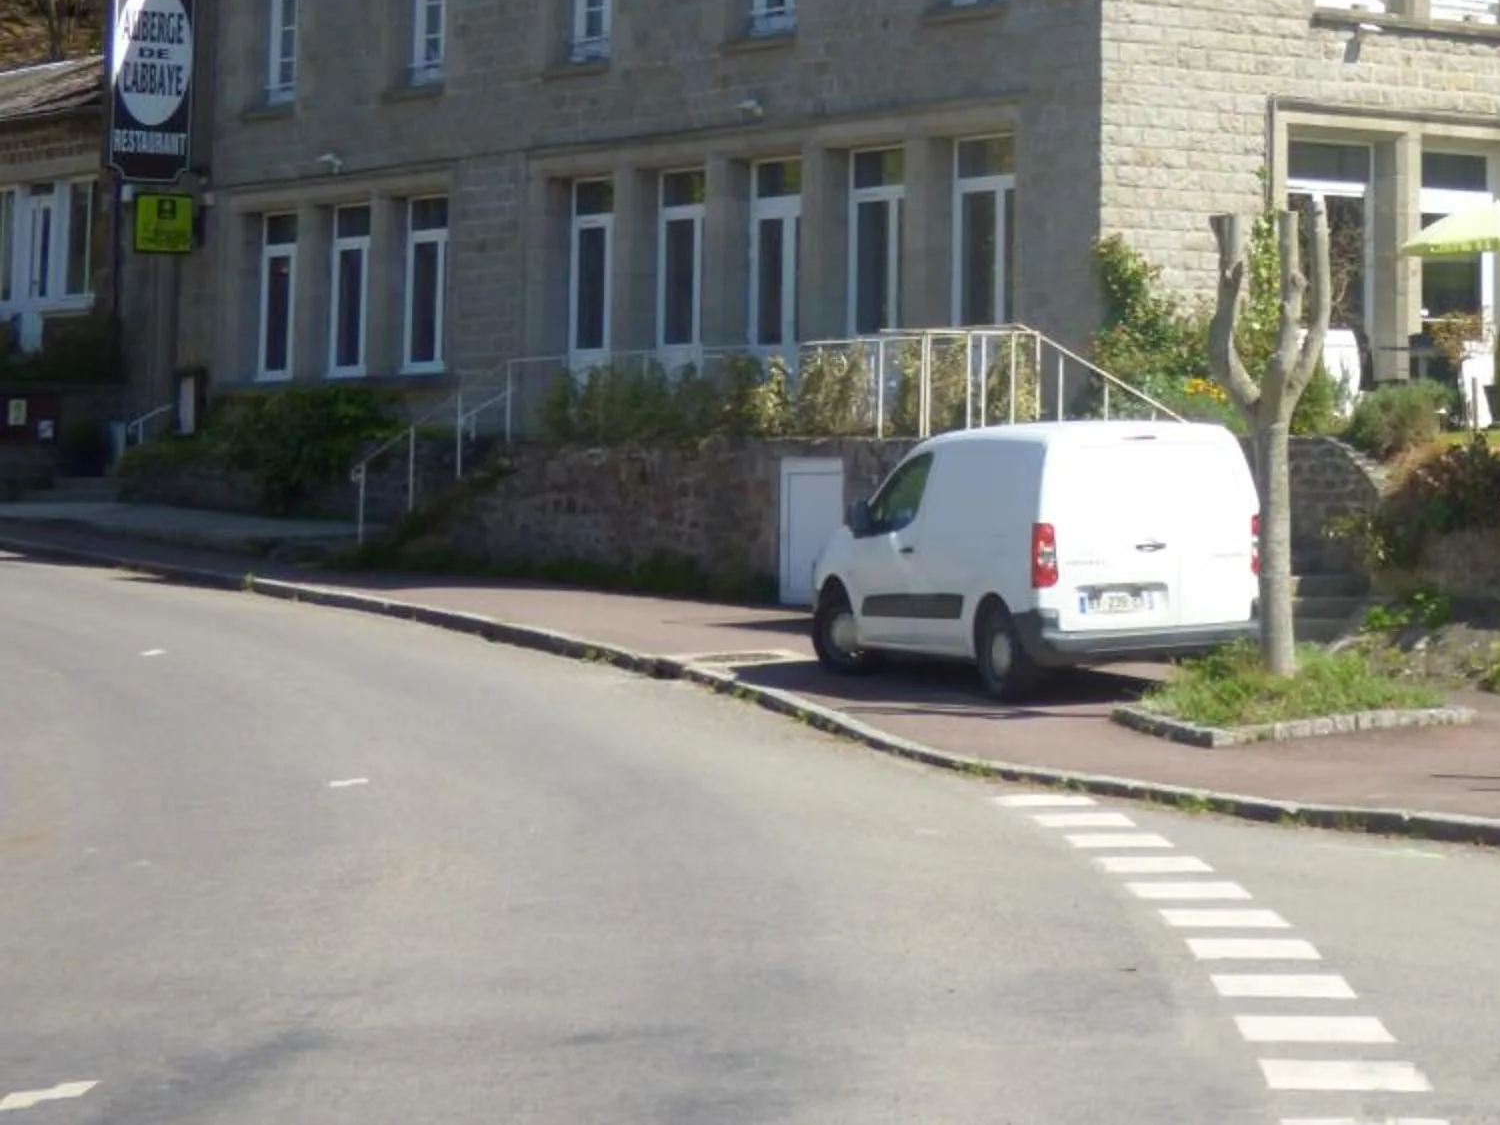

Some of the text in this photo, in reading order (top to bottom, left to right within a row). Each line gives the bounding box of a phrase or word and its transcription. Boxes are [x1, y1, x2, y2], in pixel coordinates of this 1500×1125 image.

[122, 9, 184, 45] AUBERGE
[138, 47, 171, 60] DE
[112, 129, 187, 155] RESTAURANT
